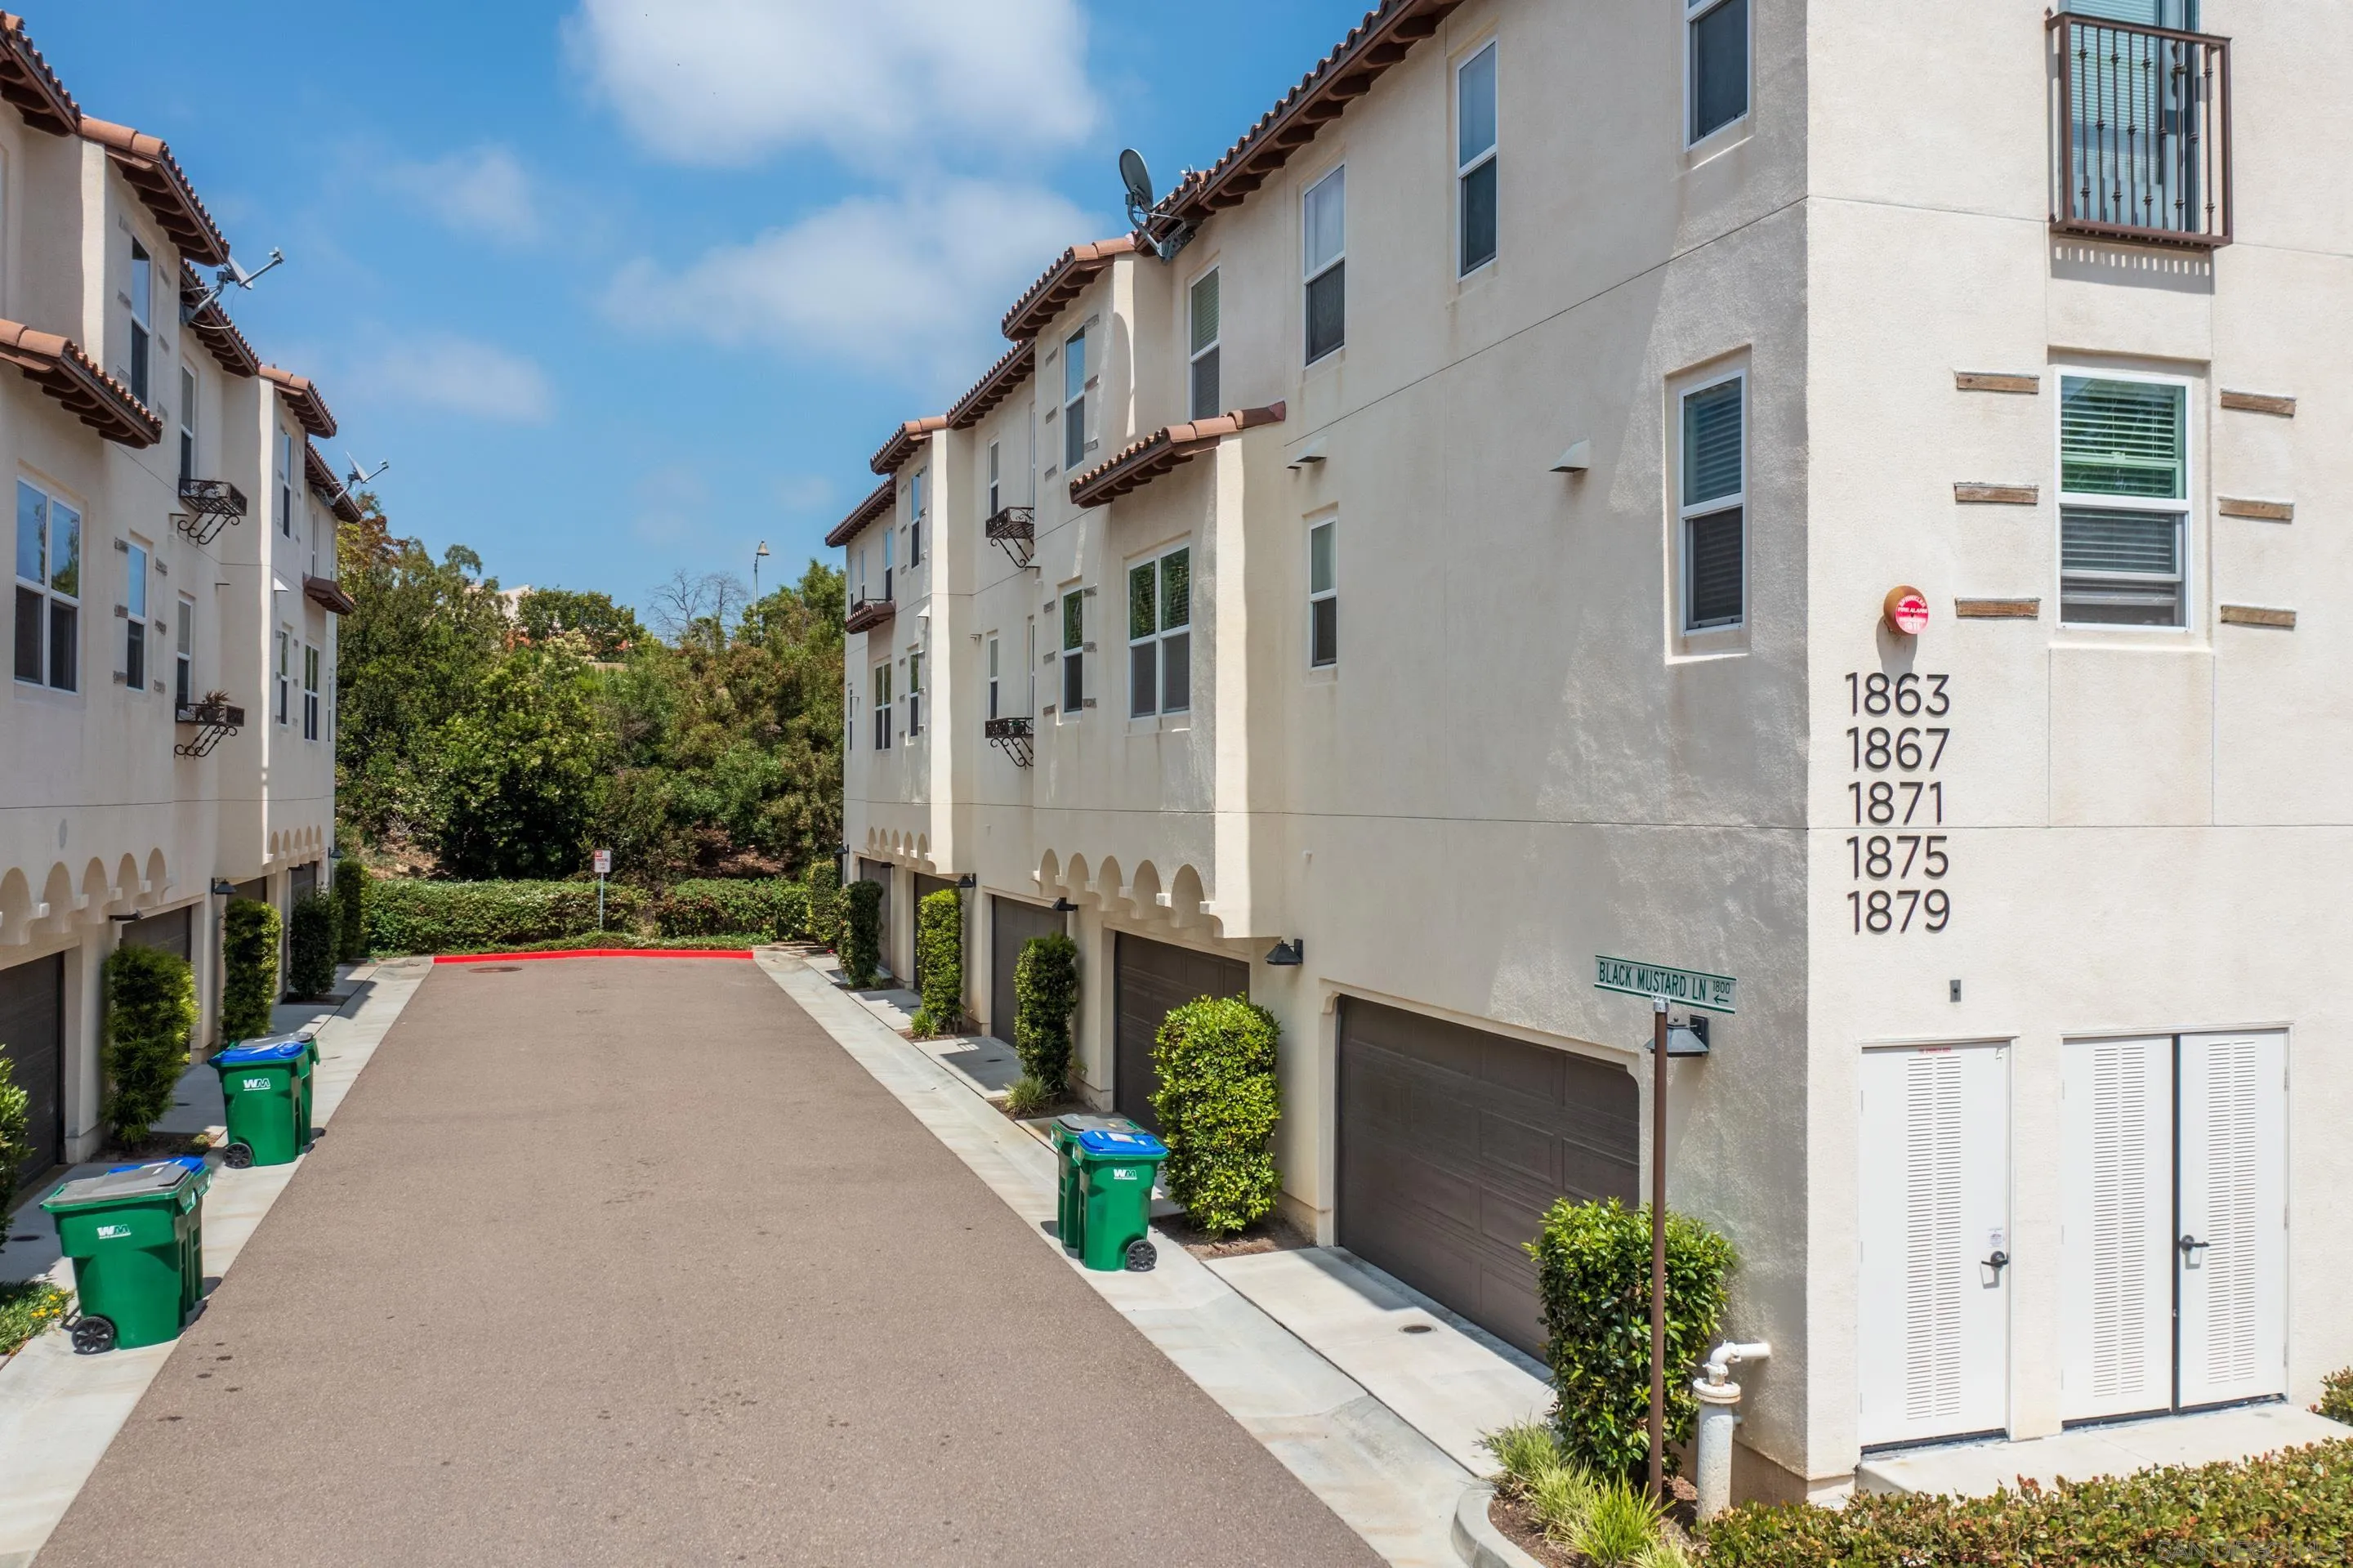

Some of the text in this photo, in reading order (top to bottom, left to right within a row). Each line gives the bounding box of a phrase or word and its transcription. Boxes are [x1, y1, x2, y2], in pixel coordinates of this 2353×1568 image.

[1845, 672, 1950, 716] 1863
[1846, 726, 1950, 771] 1867
[1848, 781, 1942, 824] 1871
[1846, 835, 1949, 878] 1875
[1847, 889, 1950, 933] 1879
[1599, 962, 1730, 1001] BLACK MUSTARD LN 1800
[243, 1078, 270, 1088] WM
[1113, 1168, 1137, 1177] WM
[96, 1224, 130, 1236] WM
